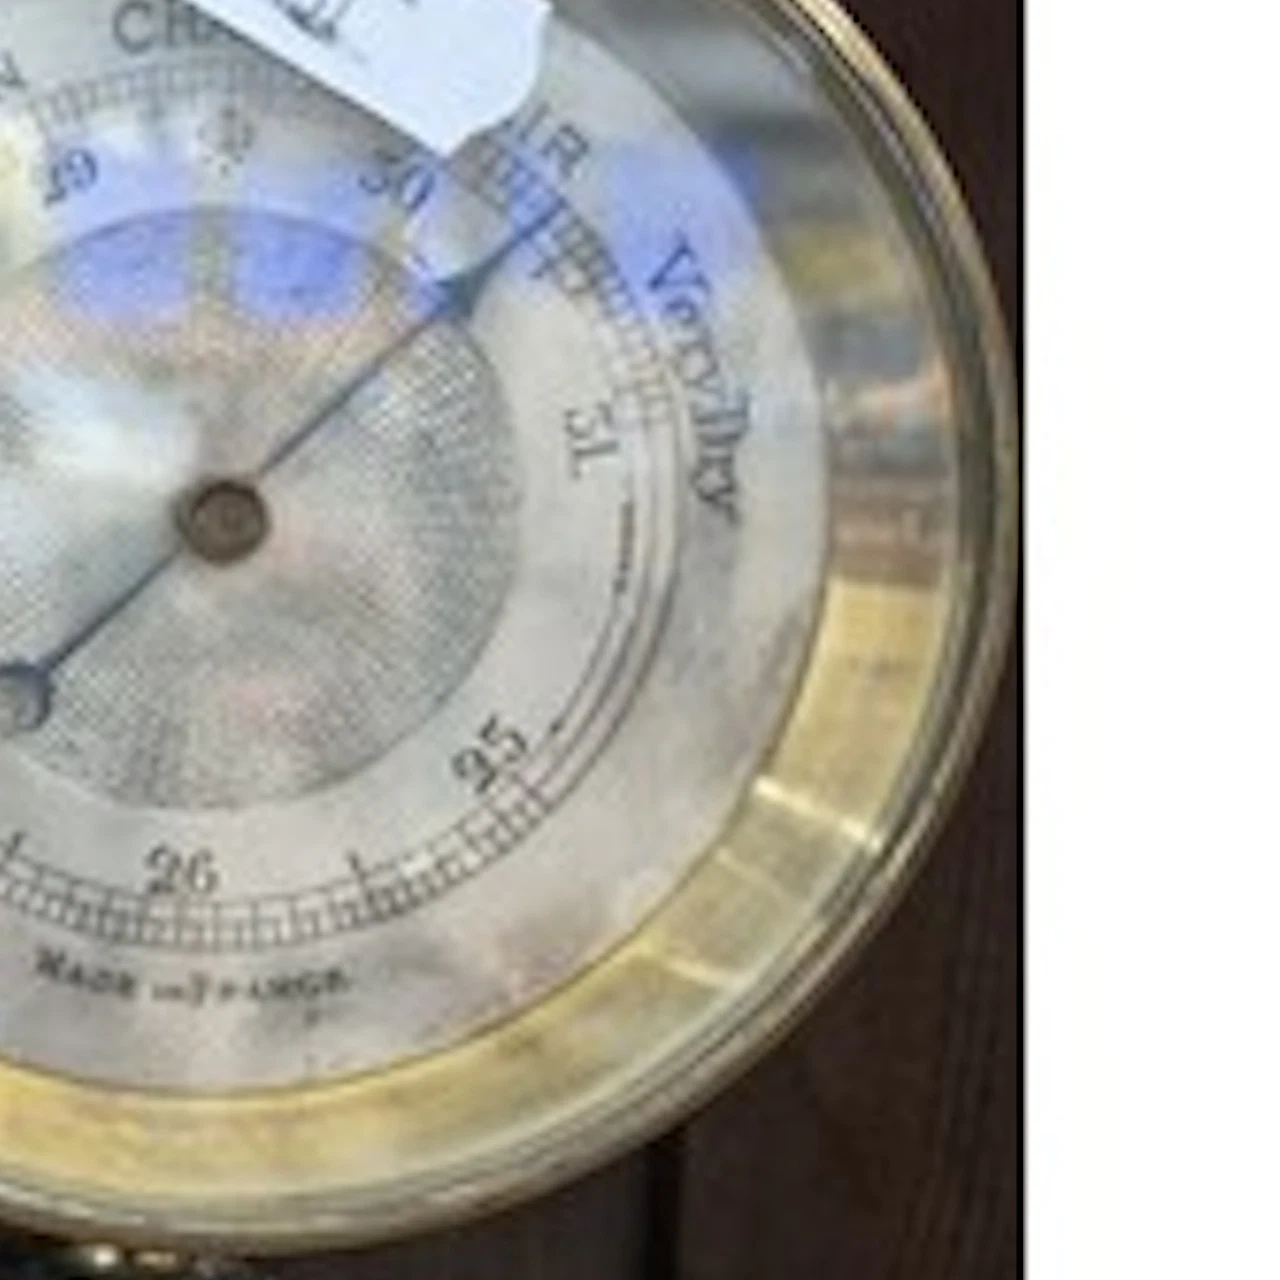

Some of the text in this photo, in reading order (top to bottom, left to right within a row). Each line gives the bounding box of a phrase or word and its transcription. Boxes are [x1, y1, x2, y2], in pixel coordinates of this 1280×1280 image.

[562, 400, 622, 482] 31
[450, 714, 529, 794] 25
[144, 841, 221, 897] 26
